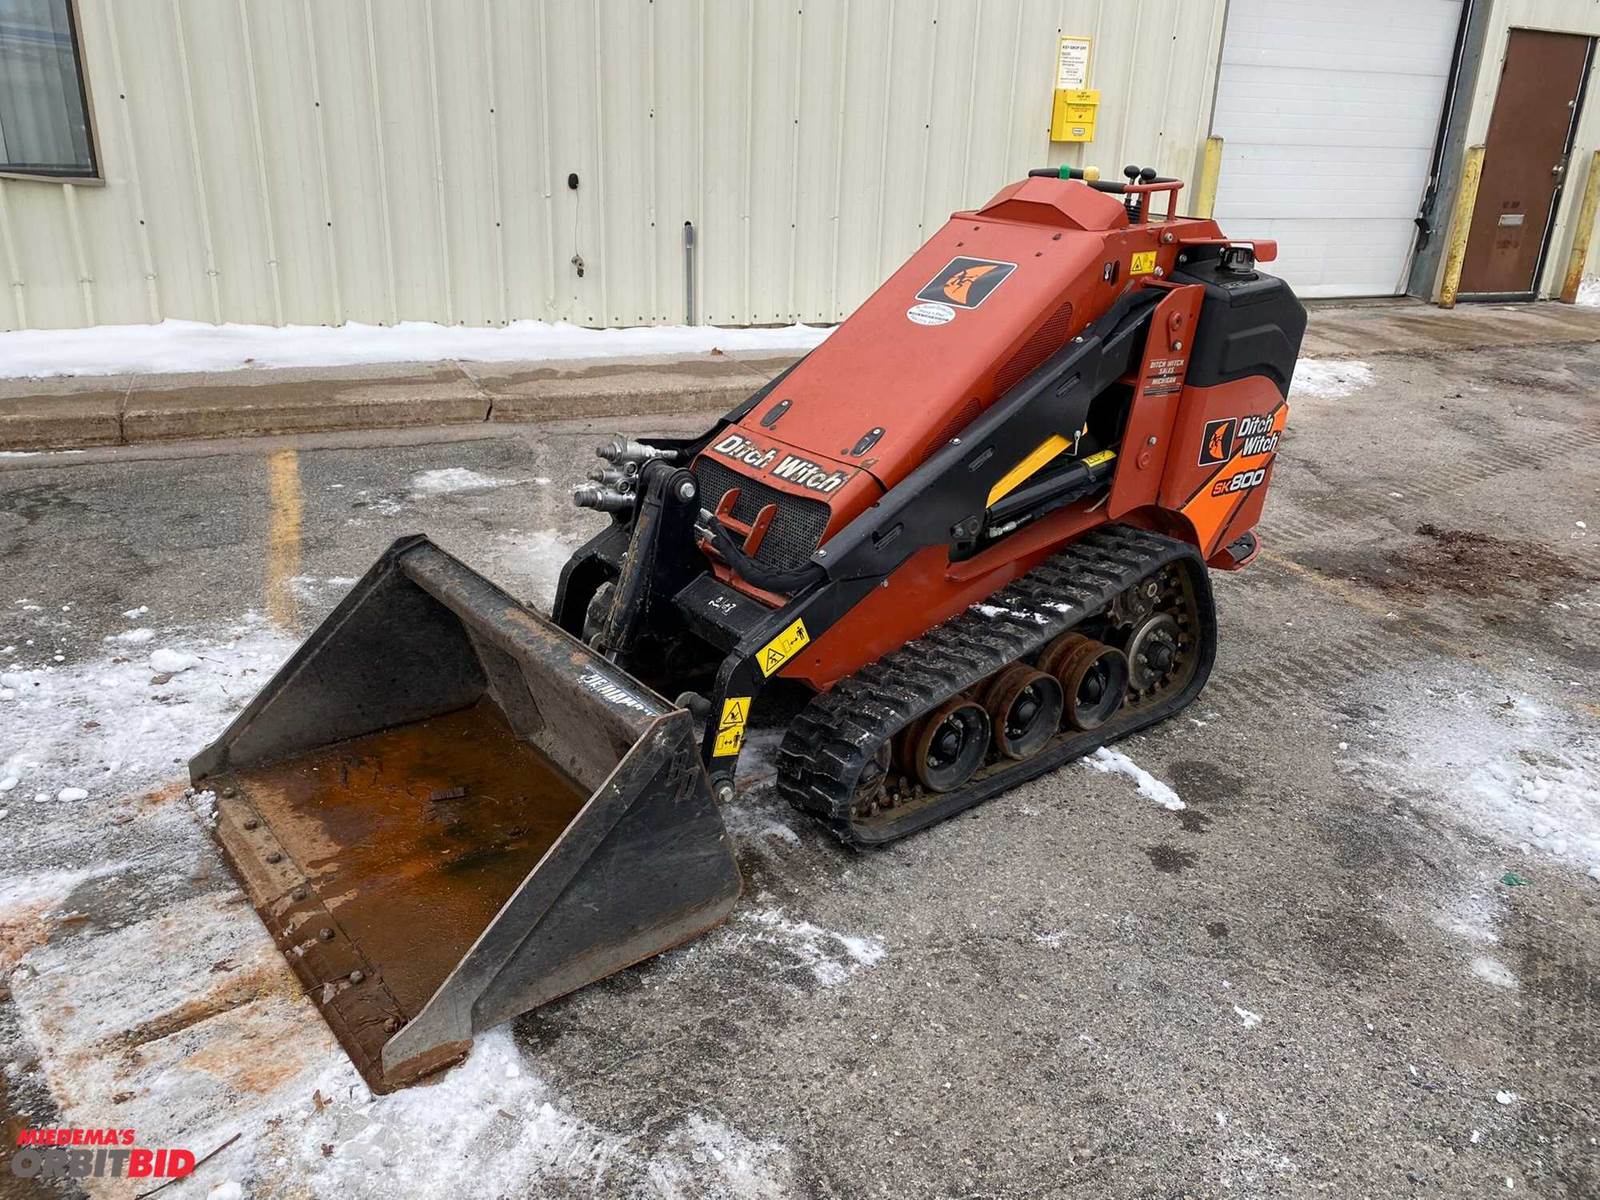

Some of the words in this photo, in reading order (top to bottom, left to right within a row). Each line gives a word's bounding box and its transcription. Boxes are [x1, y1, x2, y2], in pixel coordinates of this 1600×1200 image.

[1238, 414, 1274, 437] Ditch
[1242, 432, 1279, 456] Witch
[713, 434, 777, 469] Ditch
[772, 456, 843, 492] Witch
[1212, 468, 1266, 496] SK800
